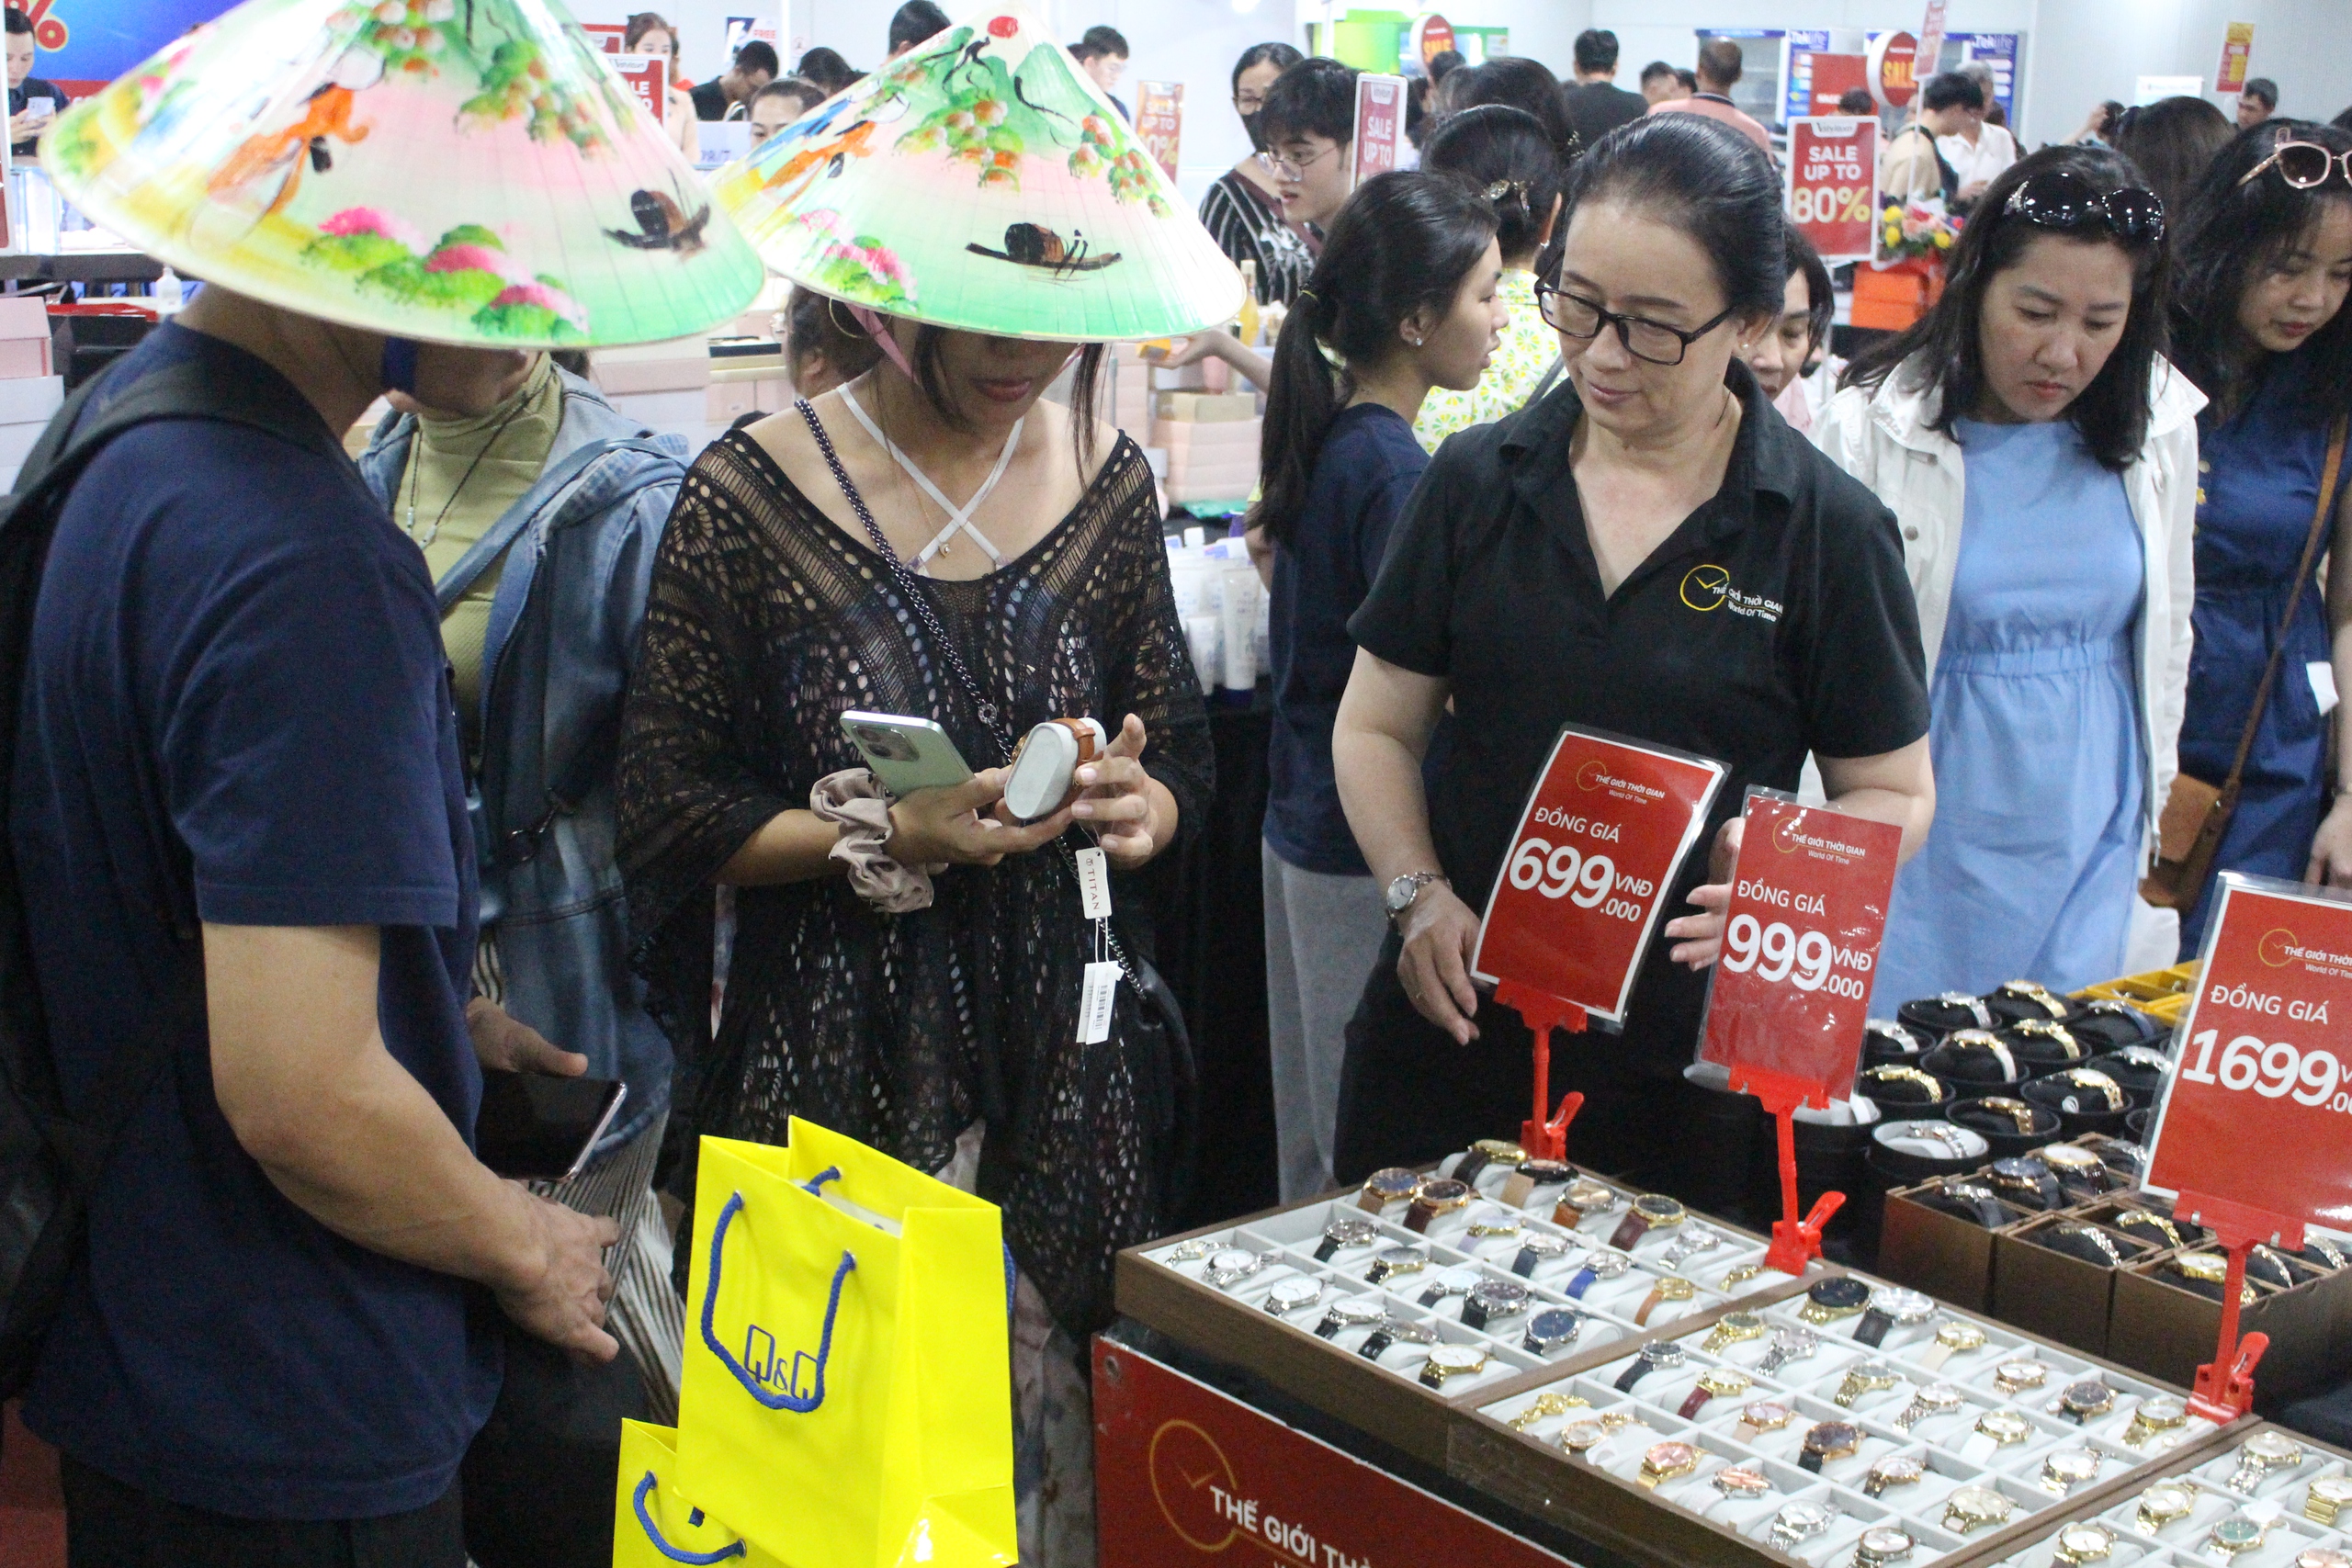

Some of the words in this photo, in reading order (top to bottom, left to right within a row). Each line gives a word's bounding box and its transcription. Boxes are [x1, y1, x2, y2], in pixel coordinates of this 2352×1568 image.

[1367, 116, 1393, 141] SALE
[1363, 141, 1378, 164] UP
[1379, 144, 1392, 168] TO
[1808, 145, 1858, 163] SALE
[1804, 164, 1831, 181] UP
[1835, 164, 1862, 181] TO
[1792, 186, 1871, 223] 80%
[1746, 608, 1755, 616] Of
[1756, 609, 1777, 622] Time
[1595, 774, 1611, 784] THẾ
[1611, 778, 1626, 788] GIỚI
[1627, 782, 1645, 793] THỜI
[1645, 787, 1666, 799] GIAN
[1609, 789, 1624, 798] World
[1634, 795, 1647, 805] Time
[1534, 806, 1587, 833] ĐỒNG
[1589, 824, 1622, 843] GIÁ
[1792, 833, 1807, 843] THẾ
[1807, 837, 1824, 848] GIỚI
[1826, 840, 1845, 852] THỜI
[1846, 845, 1866, 856] GIAN
[1808, 850, 1825, 860] World
[1835, 856, 1849, 865] Time
[1510, 838, 1615, 908] 699
[1615, 872, 1653, 897] VNĐ
[1088, 868, 1100, 910] TITAN
[1737, 877, 1790, 907] ĐỒNG
[1794, 894, 1826, 916] GIÁ
[1723, 914, 1833, 991] 999
[1832, 945, 1872, 971] VNĐ
[2284, 945, 2305, 957] THẾ
[2305, 950, 2326, 961] GIỚI
[2305, 963, 2327, 974] World
[2328, 967, 2338, 976] Of
[2211, 982, 2282, 1015] ĐỒNG
[2288, 1000, 2329, 1024] GIÁ
[2182, 1028, 2339, 1107] 1699
[1209, 1484, 1259, 1533] THẾ
[1264, 1516, 1316, 1562] GIỚI
